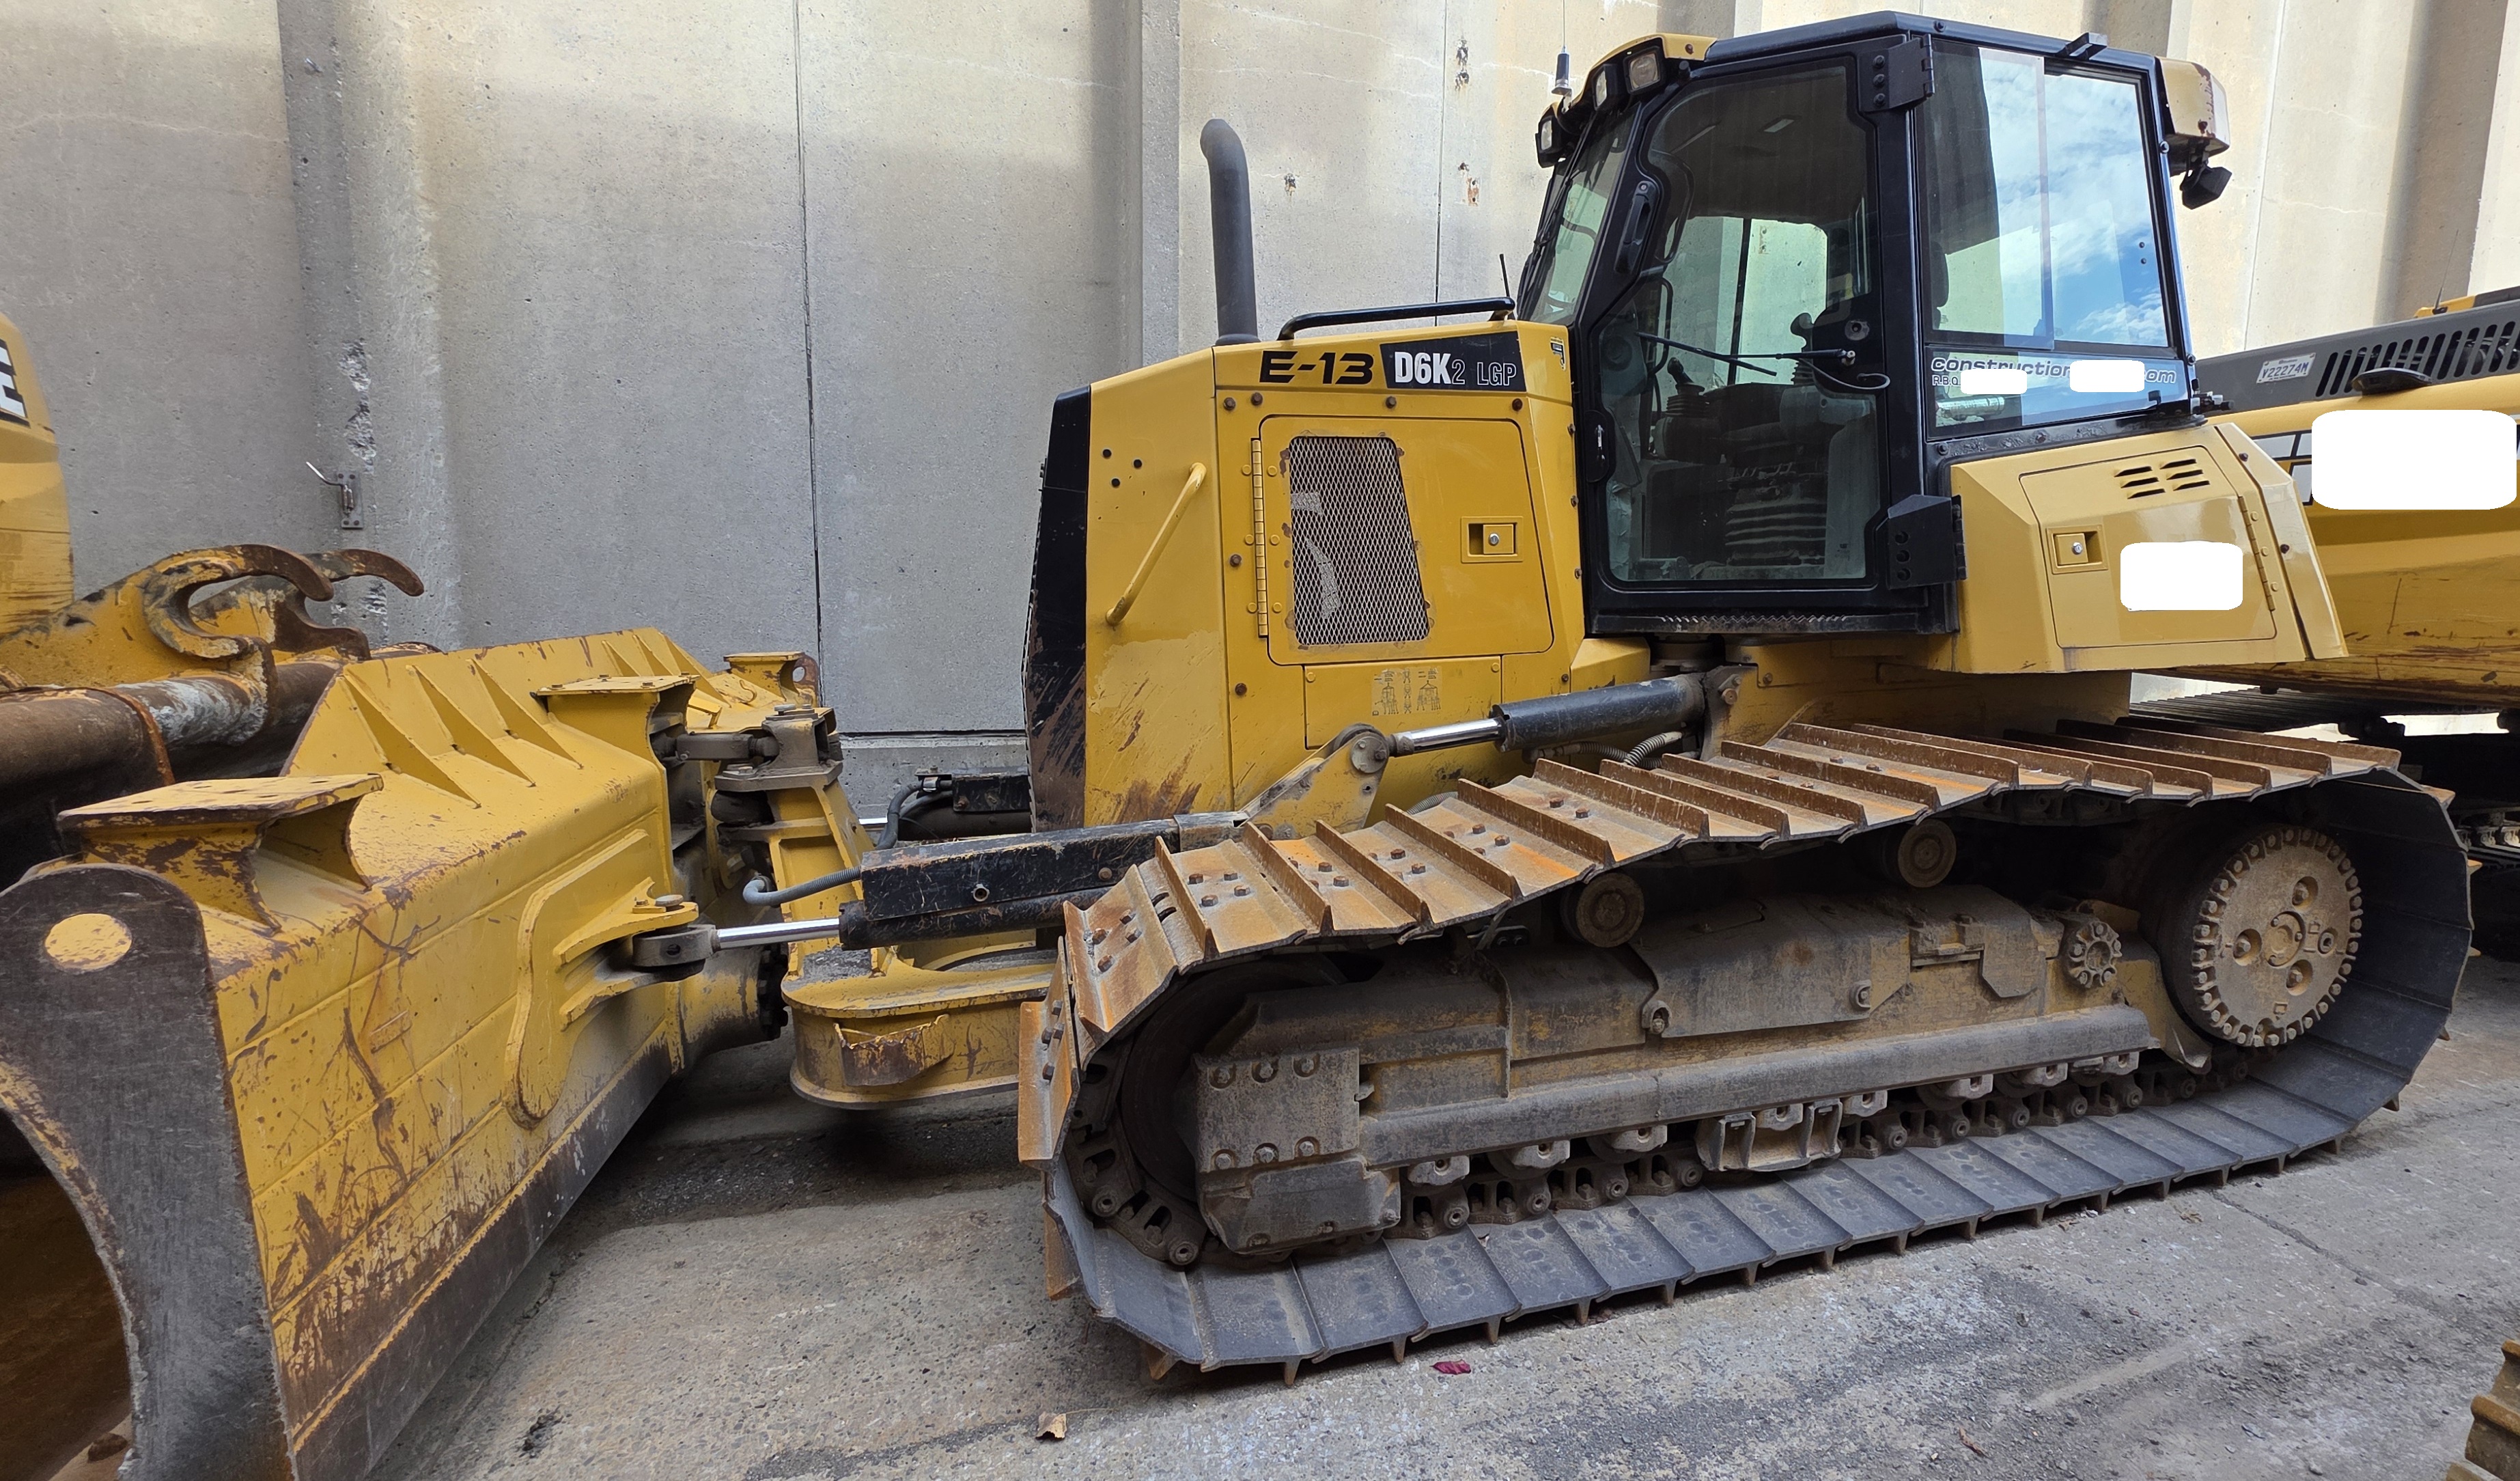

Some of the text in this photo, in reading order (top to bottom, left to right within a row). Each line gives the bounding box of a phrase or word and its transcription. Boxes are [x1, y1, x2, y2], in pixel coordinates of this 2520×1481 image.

[1259, 350, 1374, 385] E-13
[1395, 351, 1517, 386] D6K2 LGP
